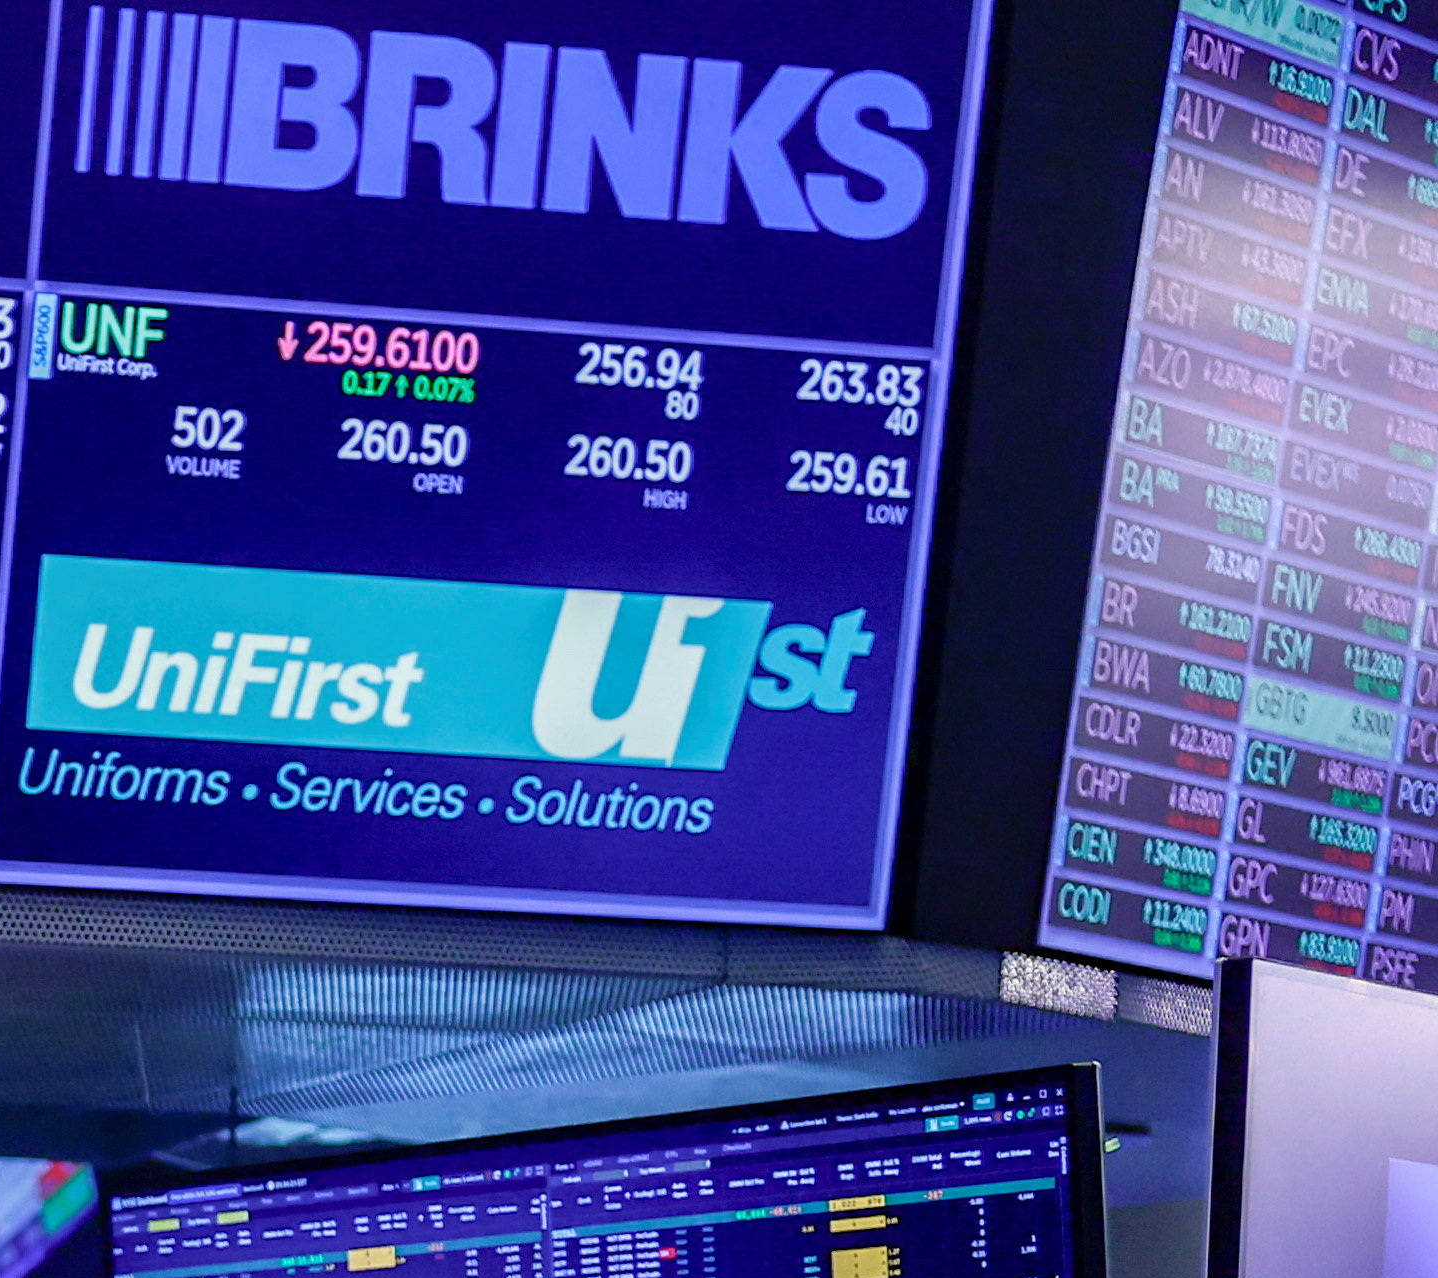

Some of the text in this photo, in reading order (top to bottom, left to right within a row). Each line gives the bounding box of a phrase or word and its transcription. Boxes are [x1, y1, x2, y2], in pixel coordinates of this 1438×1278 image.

[1353, 28, 1402, 83] CVS
[224, 16, 934, 242] BRINKS
[1343, 87, 1391, 144] DAL
[60, 301, 169, 359] UNF
[303, 320, 480, 375] 259.6100
[575, 342, 703, 398] 256.94
[796, 358, 924, 412] 263.83
[664, 385, 700, 421] 80
[884, 400, 920, 437] 40
[170, 405, 245, 452] 502
[337, 417, 468, 467] 260.50
[165, 454, 242, 480] VOLUME
[412, 472, 464, 495] OPEN
[563, 433, 692, 484] 260.50
[785, 449, 911, 499] 259.61
[642, 487, 688, 510] HIGH
[865, 503, 909, 525] LOW
[1271, 565, 1324, 615] FNV
[1092, 637, 1151, 694] BWA
[1261, 624, 1314, 674] FSM
[71, 621, 426, 729] UniFirst
[17, 746, 715, 835] Uniforms Services Solutions
